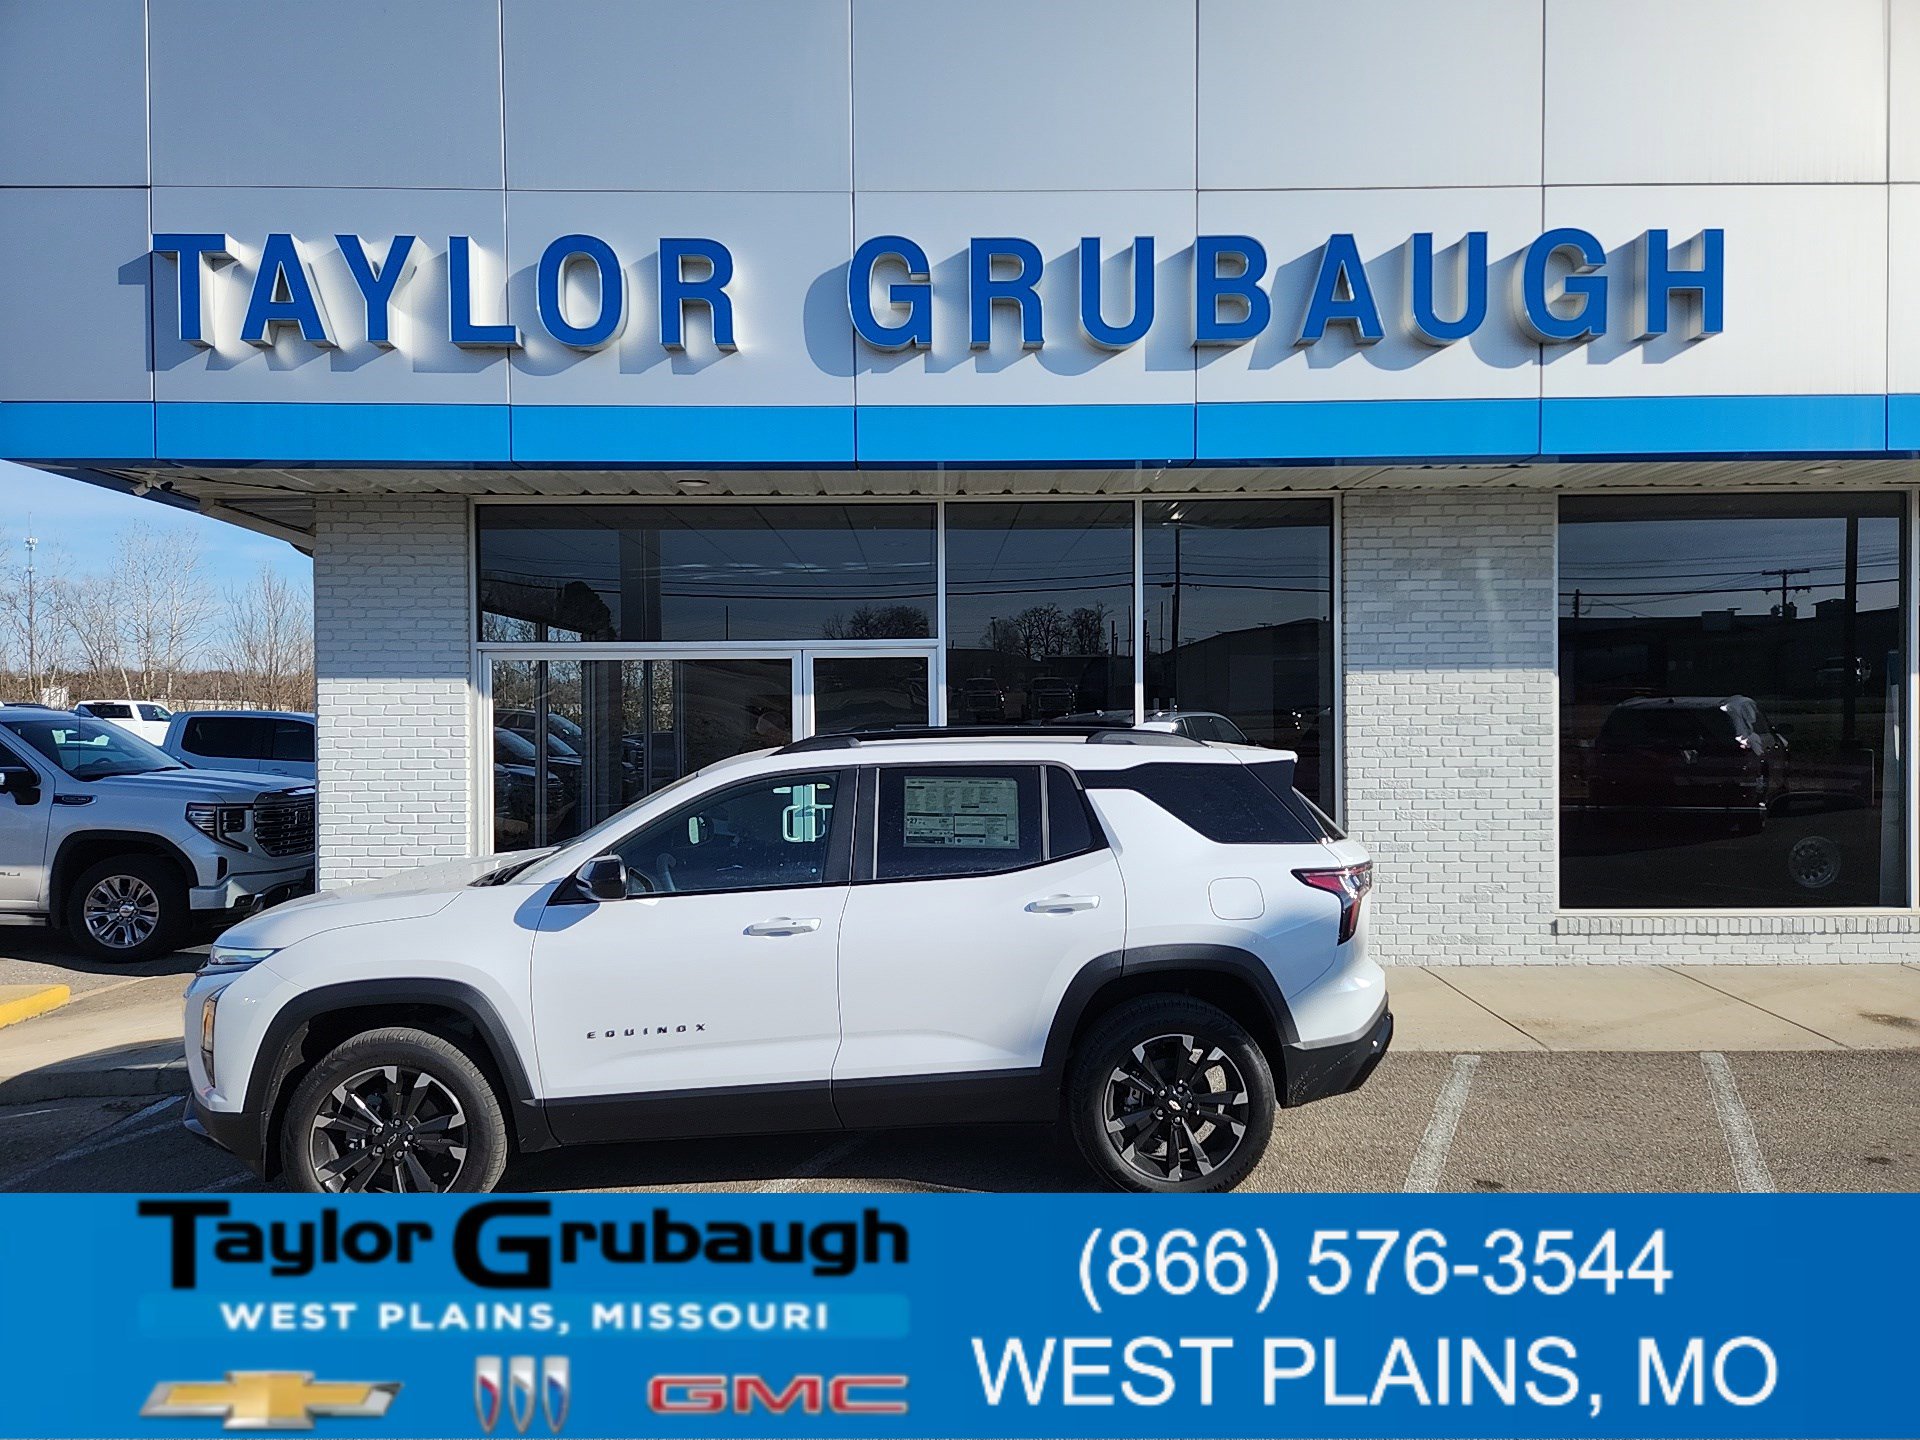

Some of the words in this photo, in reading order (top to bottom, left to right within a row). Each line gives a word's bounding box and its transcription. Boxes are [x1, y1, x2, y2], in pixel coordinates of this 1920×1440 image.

[152, 233, 737, 350] TAYLOR
[847, 228, 1724, 350] GRUBAUGH
[587, 1023, 706, 1039] EQUINOX
